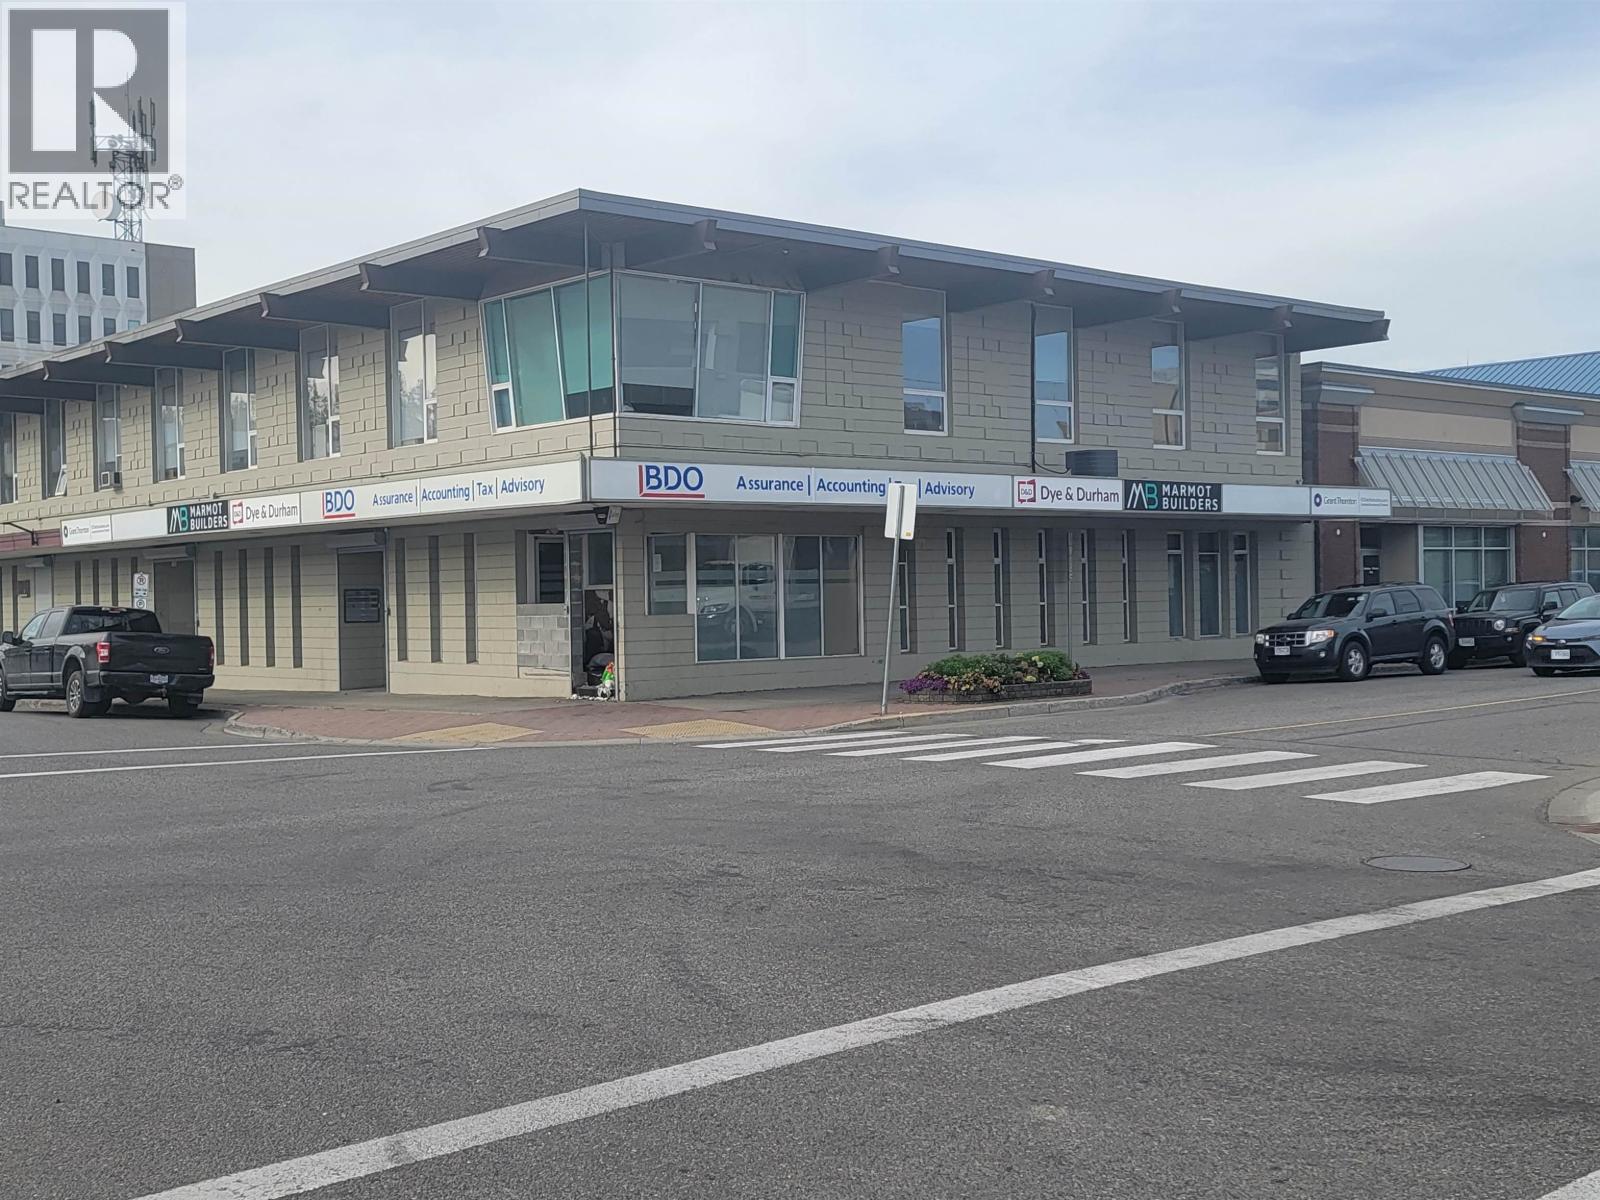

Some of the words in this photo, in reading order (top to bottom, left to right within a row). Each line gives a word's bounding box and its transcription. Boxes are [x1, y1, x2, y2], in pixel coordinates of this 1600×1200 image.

[645, 465, 704, 491] BDO
[736, 476, 804, 491] Assurance
[816, 478, 886, 497] Accounting
[925, 481, 975, 499] Advisory
[372, 491, 413, 506] Assurance
[421, 485, 470, 502] Accounting
[476, 481, 494, 497] Tax
[500, 477, 545, 495] Advisory
[1040, 485, 1063, 503] Dye
[1066, 486, 1074, 501] &
[1076, 486, 1120, 503] Durham
[1162, 484, 1212, 497] MARMOT
[190, 502, 223, 517] MARMOT
[325, 489, 355, 513] BDO
[1162, 497, 1219, 511] BUILDERS
[246, 506, 260, 522] Dye
[261, 505, 268, 518] &
[268, 502, 298, 518] Durham
[190, 515, 228, 530] BUILDERS
